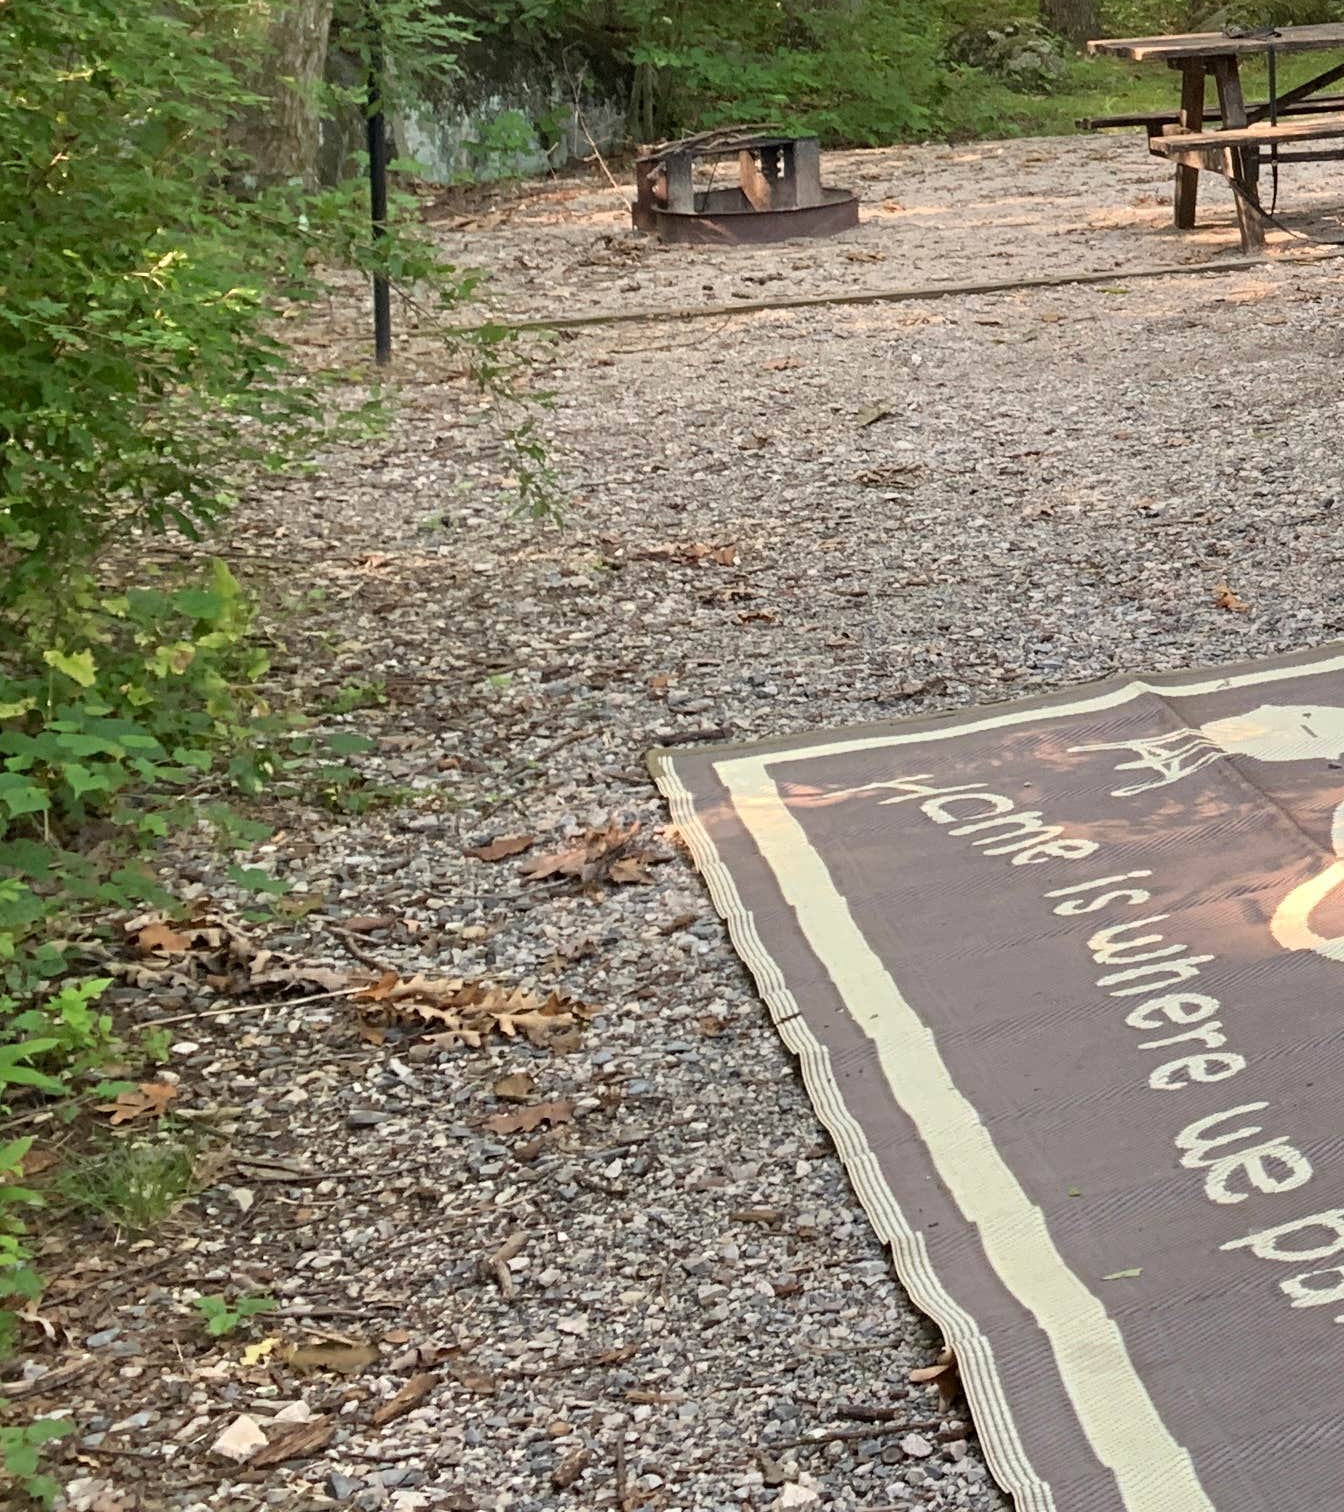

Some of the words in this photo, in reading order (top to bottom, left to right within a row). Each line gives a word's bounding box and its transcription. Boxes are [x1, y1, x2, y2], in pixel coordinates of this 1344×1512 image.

[812, 773, 1100, 866] Home
[1043, 869, 1153, 916] is
[1086, 912, 1246, 1090] where
[1174, 1100, 1313, 1204] we
